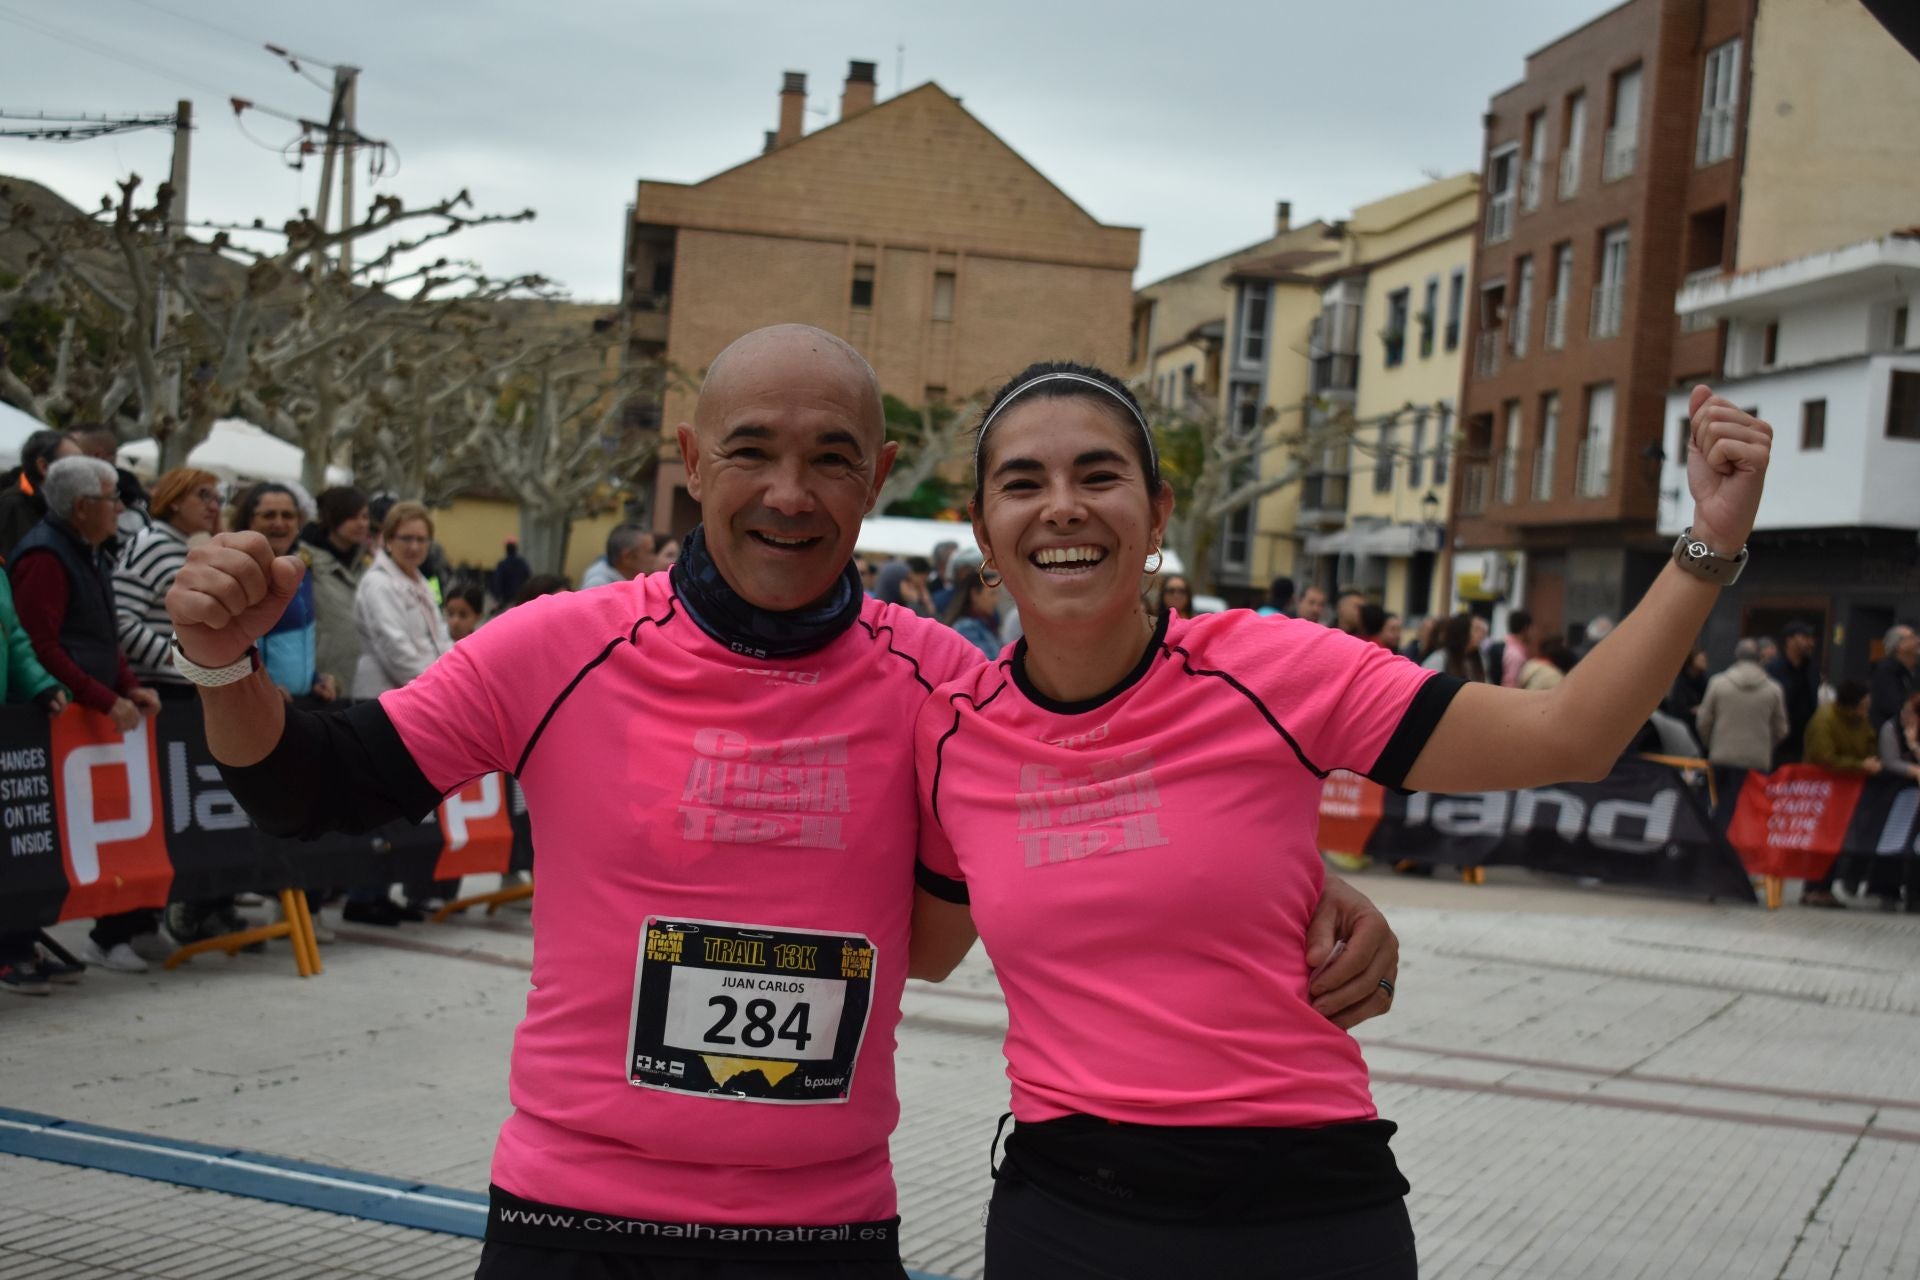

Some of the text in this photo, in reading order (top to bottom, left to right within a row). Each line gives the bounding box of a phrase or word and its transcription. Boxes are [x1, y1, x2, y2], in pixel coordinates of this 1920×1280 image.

[0, 748, 46, 771] HANGES
[1, 775, 49, 800] STARTS
[4, 802, 51, 829] ON THE
[11, 830, 54, 857] INSIDE
[703, 936, 818, 971] TRAIL 13K
[722, 977, 805, 994] JUAN CARLOS
[703, 995, 812, 1051] 284
[804, 1075, 845, 1089] b.power
[500, 1207, 888, 1243] www.cxmalhamatrail.es
